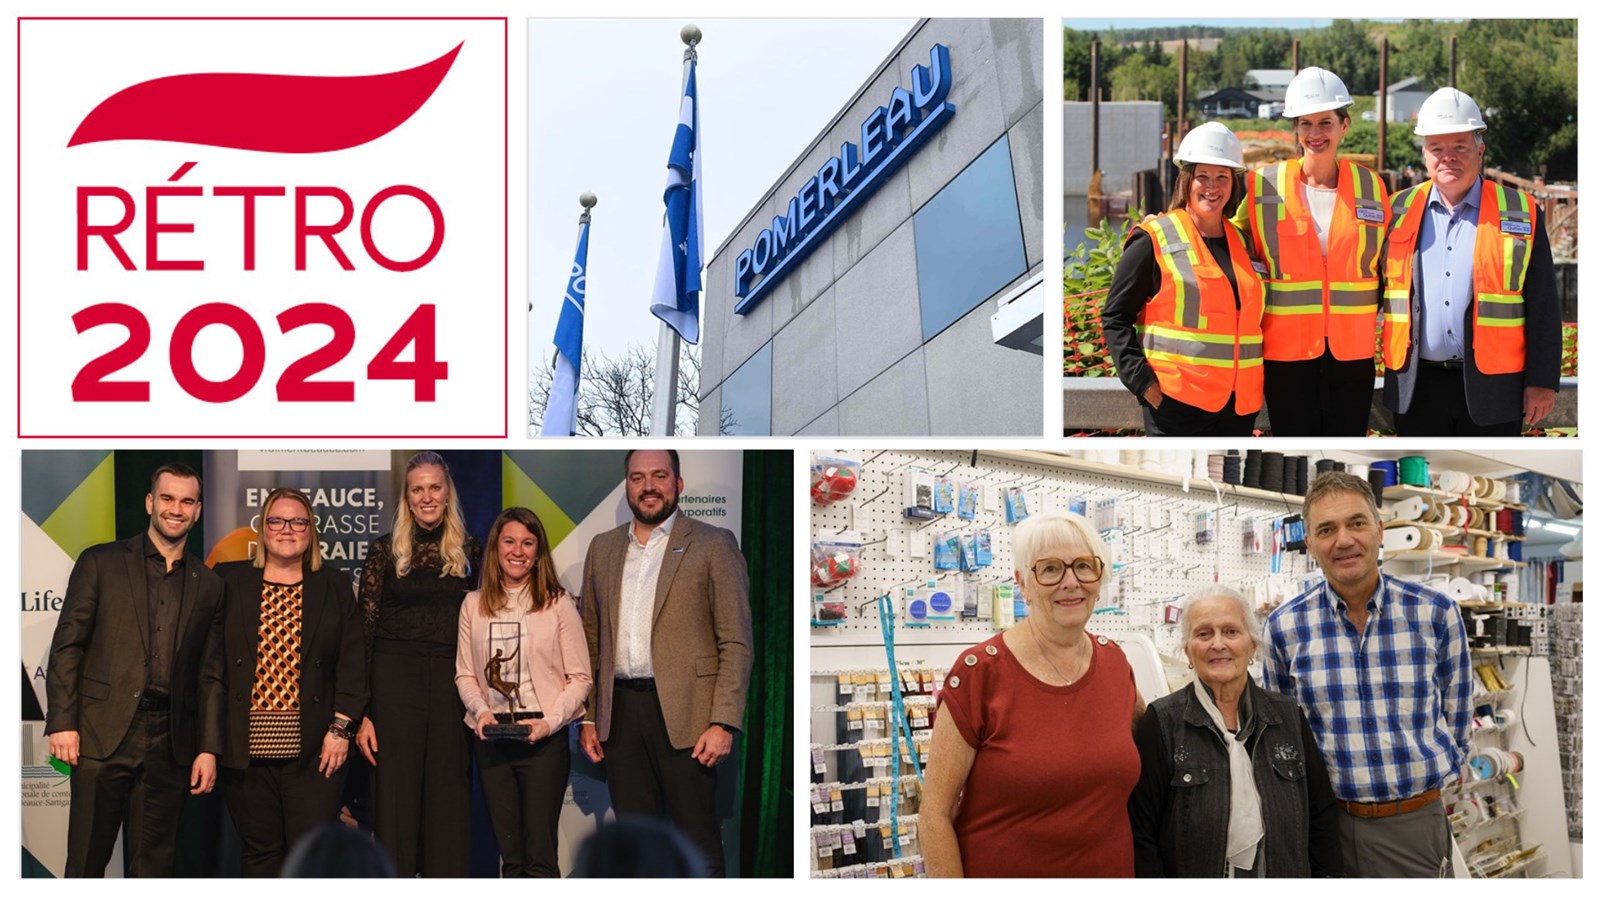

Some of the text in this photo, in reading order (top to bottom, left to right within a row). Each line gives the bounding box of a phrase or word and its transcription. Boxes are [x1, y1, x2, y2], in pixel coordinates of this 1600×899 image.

[735, 43, 952, 298] POMERLEAU
[301, 487, 384, 510] AUCE,
[315, 514, 379, 534] RASSE
[319, 541, 369, 560] RAIE
